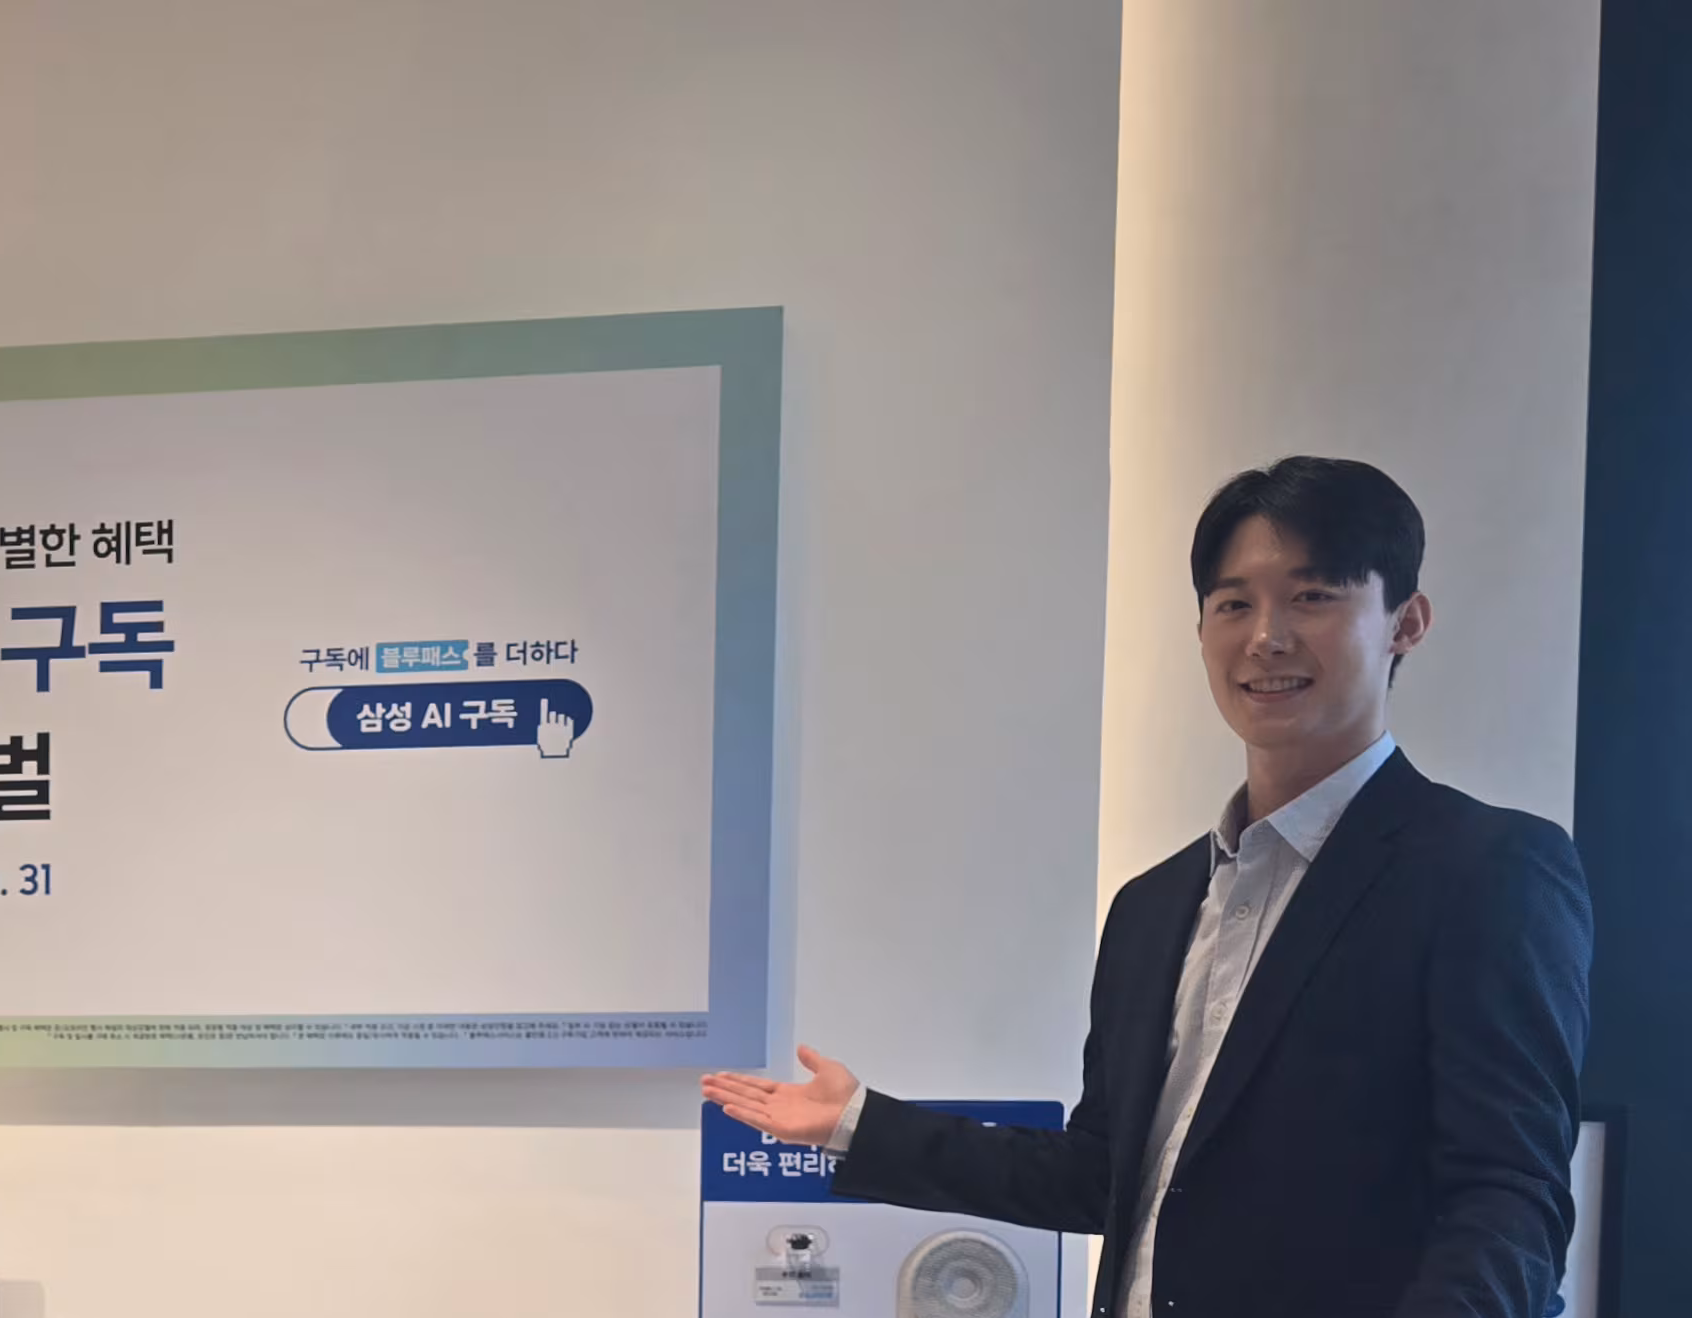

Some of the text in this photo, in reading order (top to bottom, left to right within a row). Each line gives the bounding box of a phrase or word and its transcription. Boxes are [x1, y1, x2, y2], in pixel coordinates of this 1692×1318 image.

[91, 519, 174, 565] 혜택
[0, 600, 176, 693] 구독
[299, 639, 579, 673] 구독에 블루패스 를 더하다
[356, 698, 518, 733] 삼성 AI 구독
[19, 862, 52, 896] 31
[722, 1150, 773, 1177] 더욱
